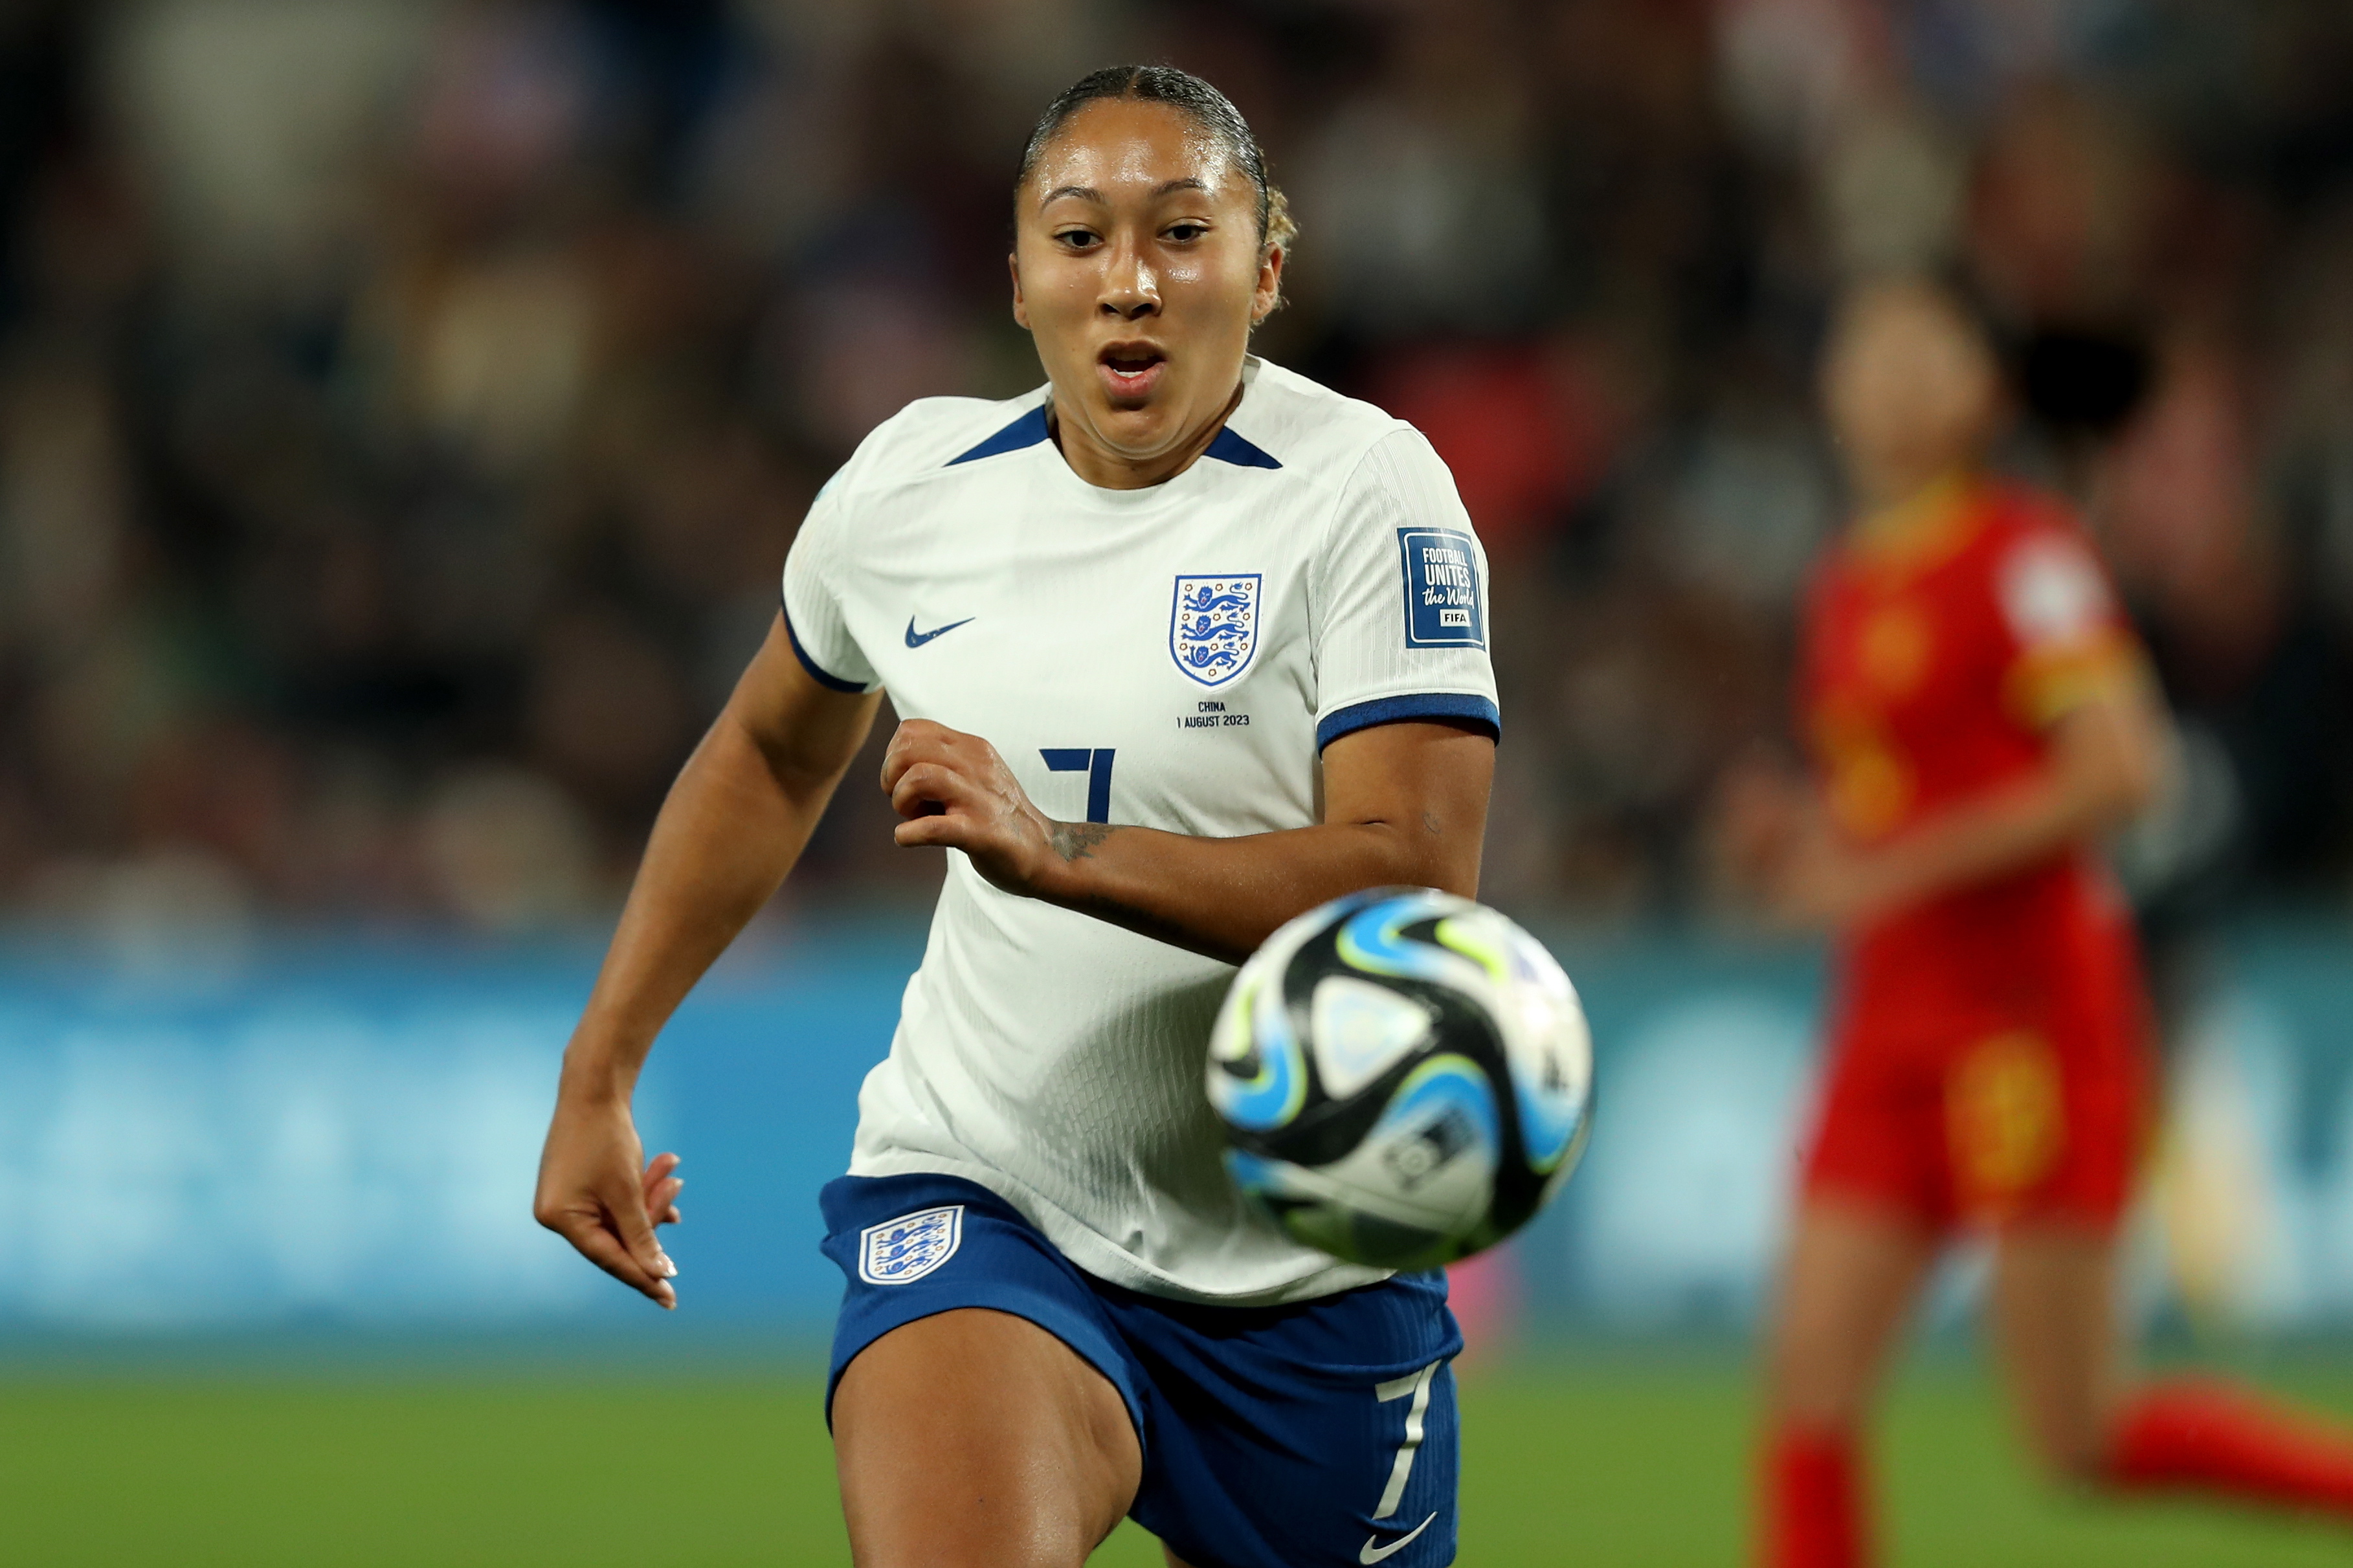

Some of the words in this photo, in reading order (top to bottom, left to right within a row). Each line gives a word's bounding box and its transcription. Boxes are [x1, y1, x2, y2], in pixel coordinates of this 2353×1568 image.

[1423, 547, 1467, 567] FOOTBALL
[1425, 564, 1471, 588] UNITES
[1422, 586, 1445, 606] the
[1446, 588, 1475, 610] World
[1445, 613, 1466, 623] FIFA
[1198, 701, 1225, 712] CHINA
[1177, 717, 1181, 729] 1
[1185, 716, 1220, 728] AUGUST
[1223, 715, 1249, 726] 2023
[1038, 749, 1116, 824] 7
[1371, 1358, 1443, 1521] 7
